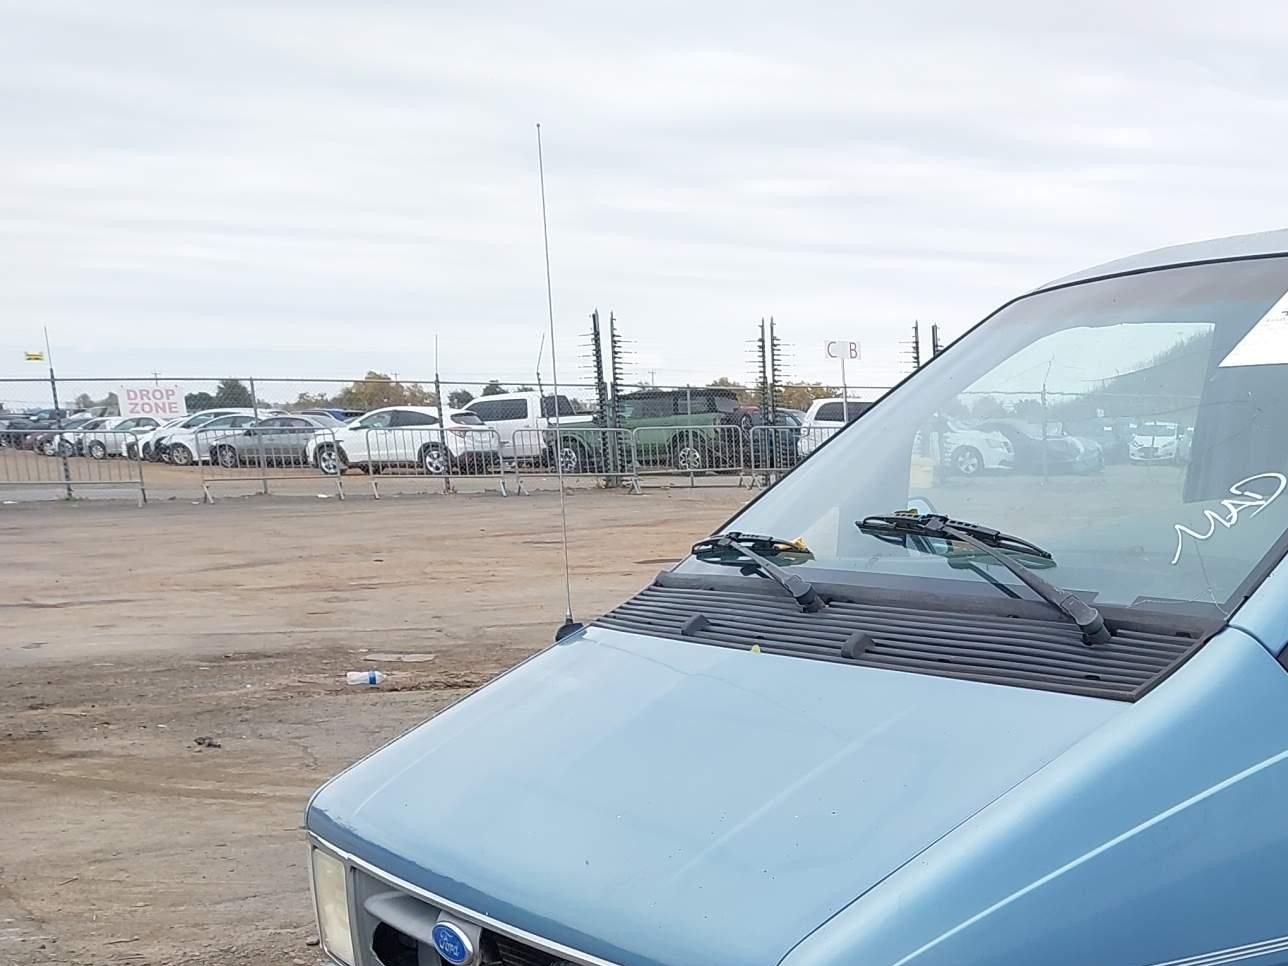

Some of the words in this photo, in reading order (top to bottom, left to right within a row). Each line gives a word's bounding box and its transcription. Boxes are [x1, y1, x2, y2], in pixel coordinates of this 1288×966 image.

[848, 341, 858, 360] B
[126, 388, 176, 402] DROP
[127, 402, 180, 415] ZONE
[438, 928, 461, 958] Ford
